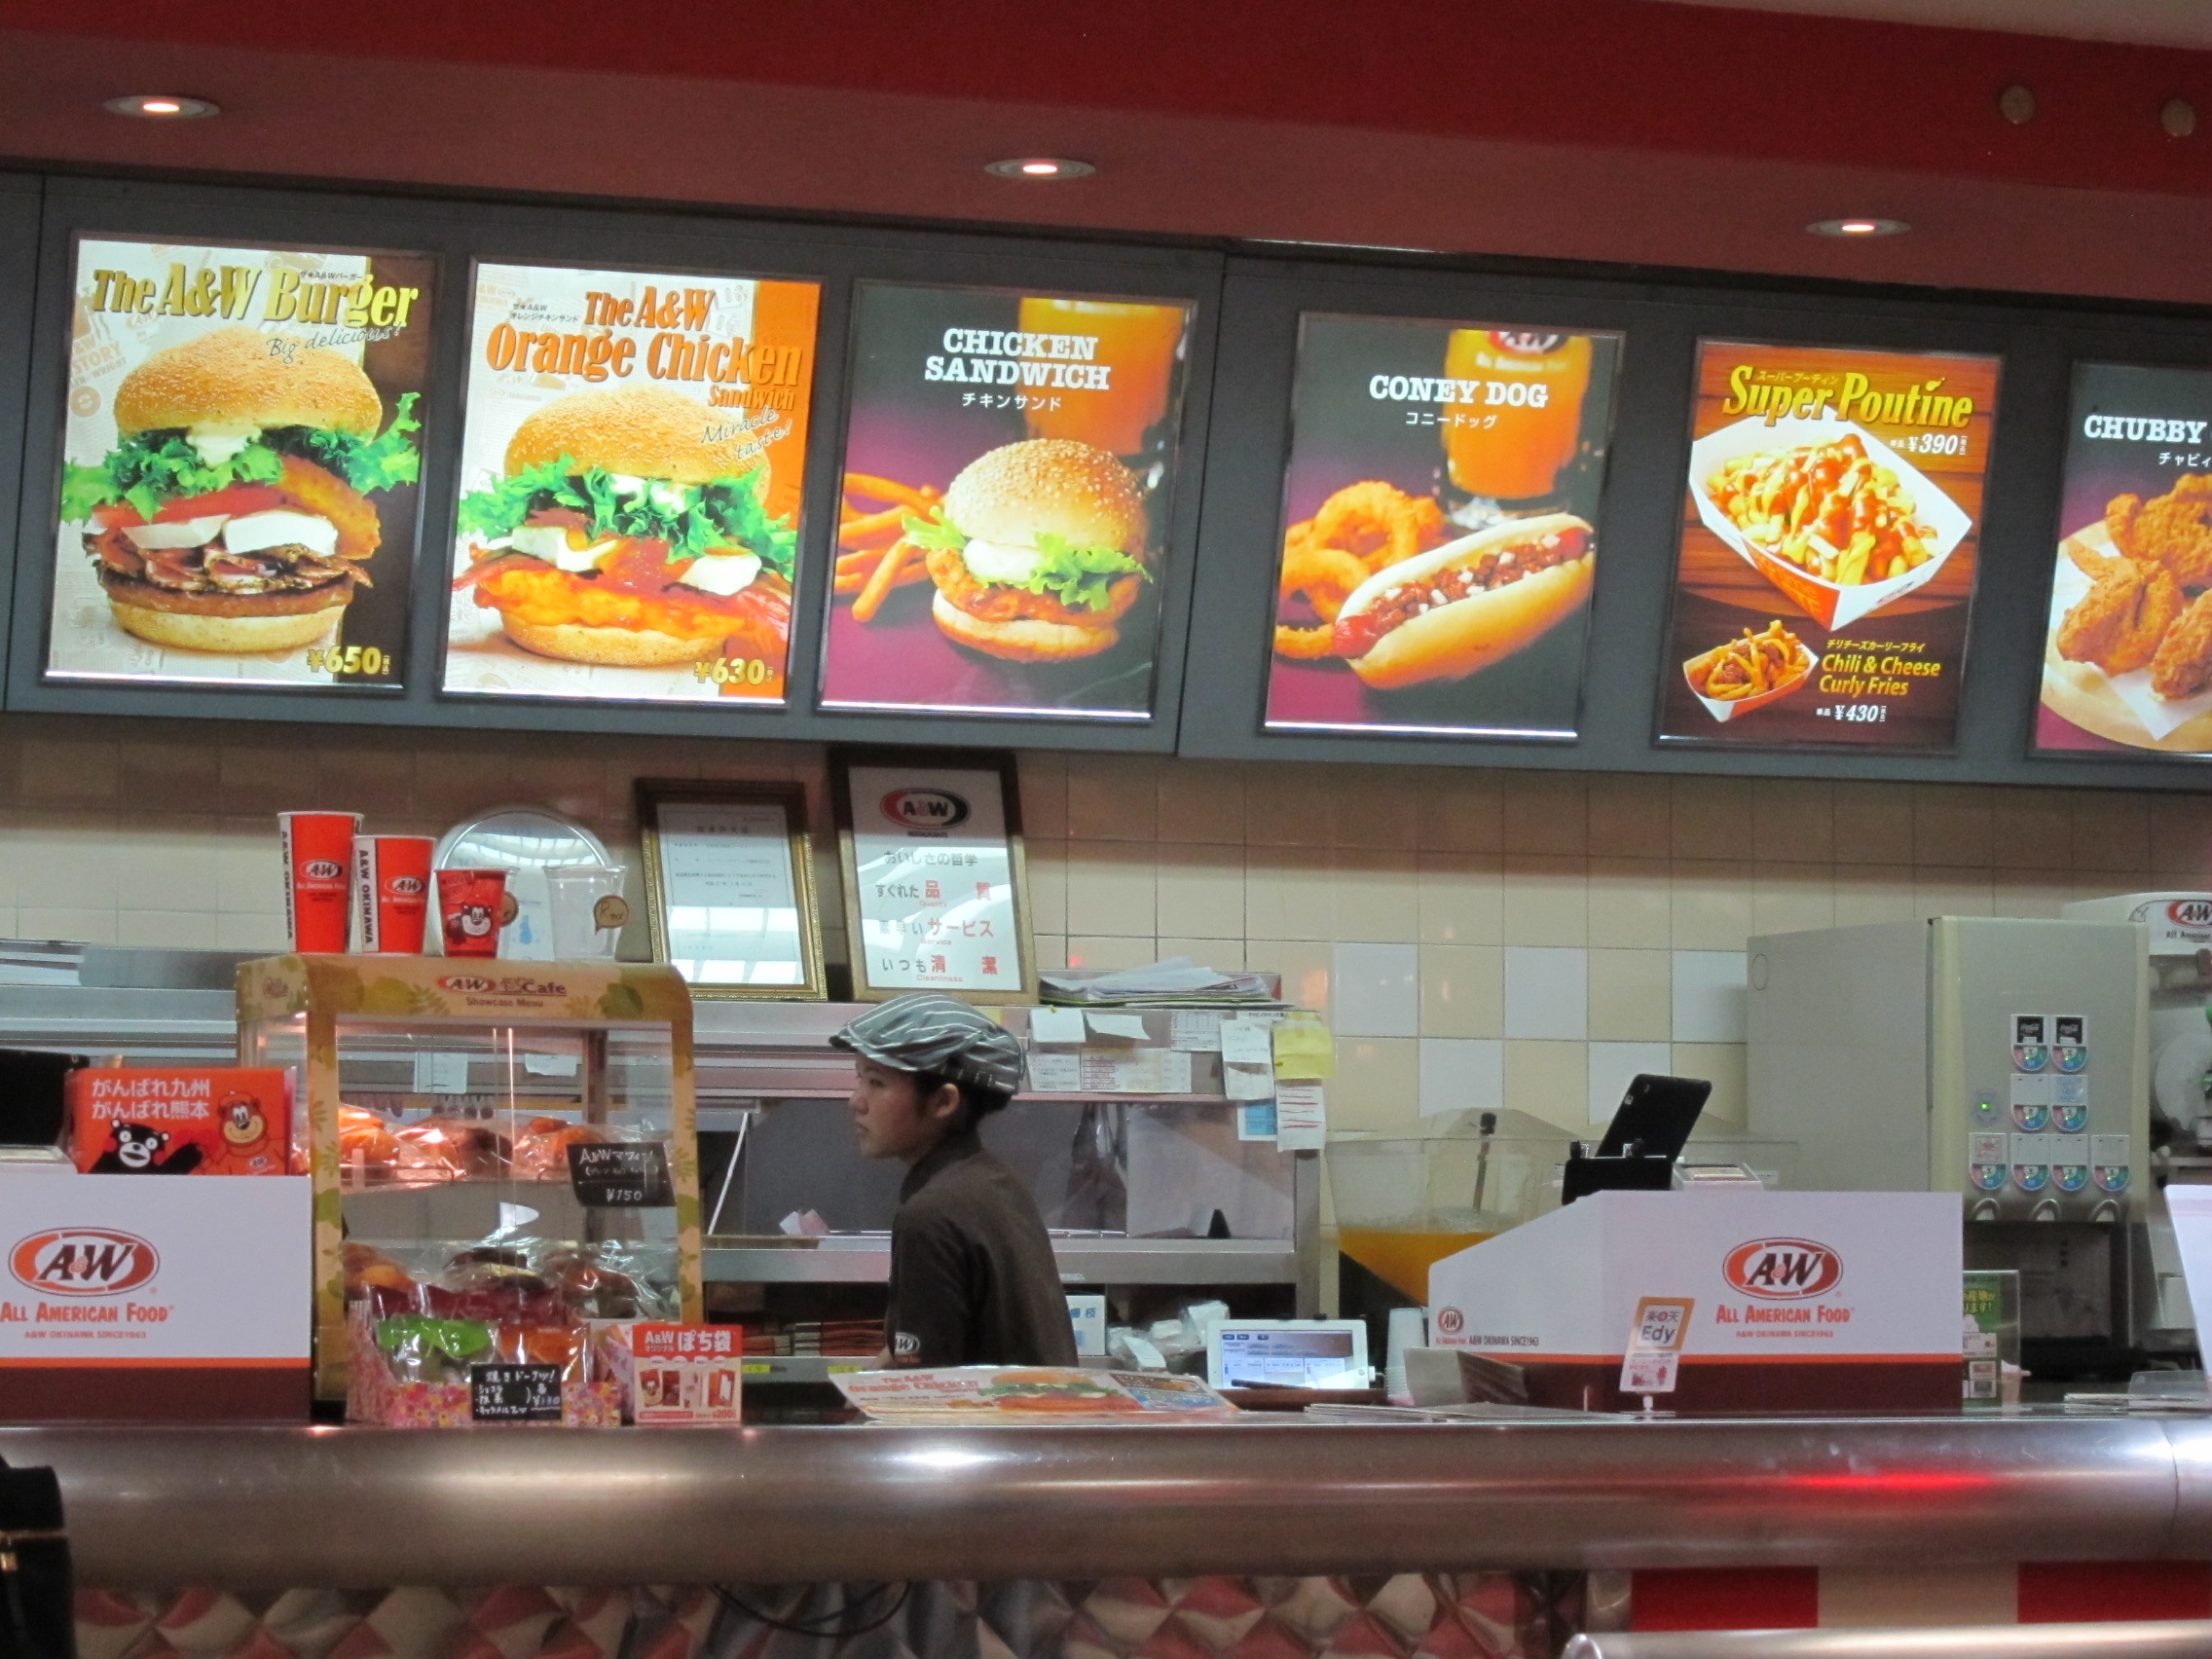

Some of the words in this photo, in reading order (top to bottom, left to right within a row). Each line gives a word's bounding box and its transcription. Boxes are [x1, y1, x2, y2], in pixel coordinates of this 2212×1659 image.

[93, 270, 155, 313] The
[156, 263, 262, 320] A&W
[264, 267, 419, 328] Burger
[510, 313, 578, 322] オレンジチキンサンド
[585, 291, 635, 327] The
[634, 286, 716, 331] A&W
[266, 338, 297, 364] Big
[305, 322, 402, 350] delicious!
[487, 322, 636, 382] Orange
[647, 332, 802, 387] Chicken
[943, 327, 1098, 360] CHICKEN
[924, 355, 1111, 389] SANDWICH
[709, 385, 795, 411] Sandwich
[961, 392, 1061, 411] チキンサンド
[1369, 375, 1480, 404] CONEY
[1485, 382, 1548, 408] DOG
[1722, 365, 1835, 426] Super
[1835, 372, 1973, 428] Poutine
[701, 405, 779, 444] Miracle
[1406, 411, 1497, 428] コニードッグ
[2083, 415, 2208, 443] CHUBBY
[737, 419, 793, 460] taste!
[1908, 433, 1959, 455] ¥390
[307, 645, 382, 675] ¥650
[693, 657, 765, 685] ¥630
[1822, 653, 1862, 674] Chili
[1863, 655, 1877, 674] &
[1881, 656, 1941, 677] Cheese
[1819, 674, 1864, 698] Curly
[1866, 676, 1909, 695] Fries
[1834, 705, 1879, 721] ¥430
[361, 884, 373, 943] OKINAWA
[522, 981, 567, 994] Cafe
[466, 997, 513, 1007] Showcase
[517, 998, 543, 1008] Menu
[92, 1078, 210, 1097] がんばれ九州
[92, 1100, 209, 1120] がんばれ熊本
[607, 1188, 643, 1202] ¥150
[645, 1331, 674, 1344] A&W
[678, 1330, 731, 1352] ぽち袋
[1641, 1325, 1676, 1344] Edy
